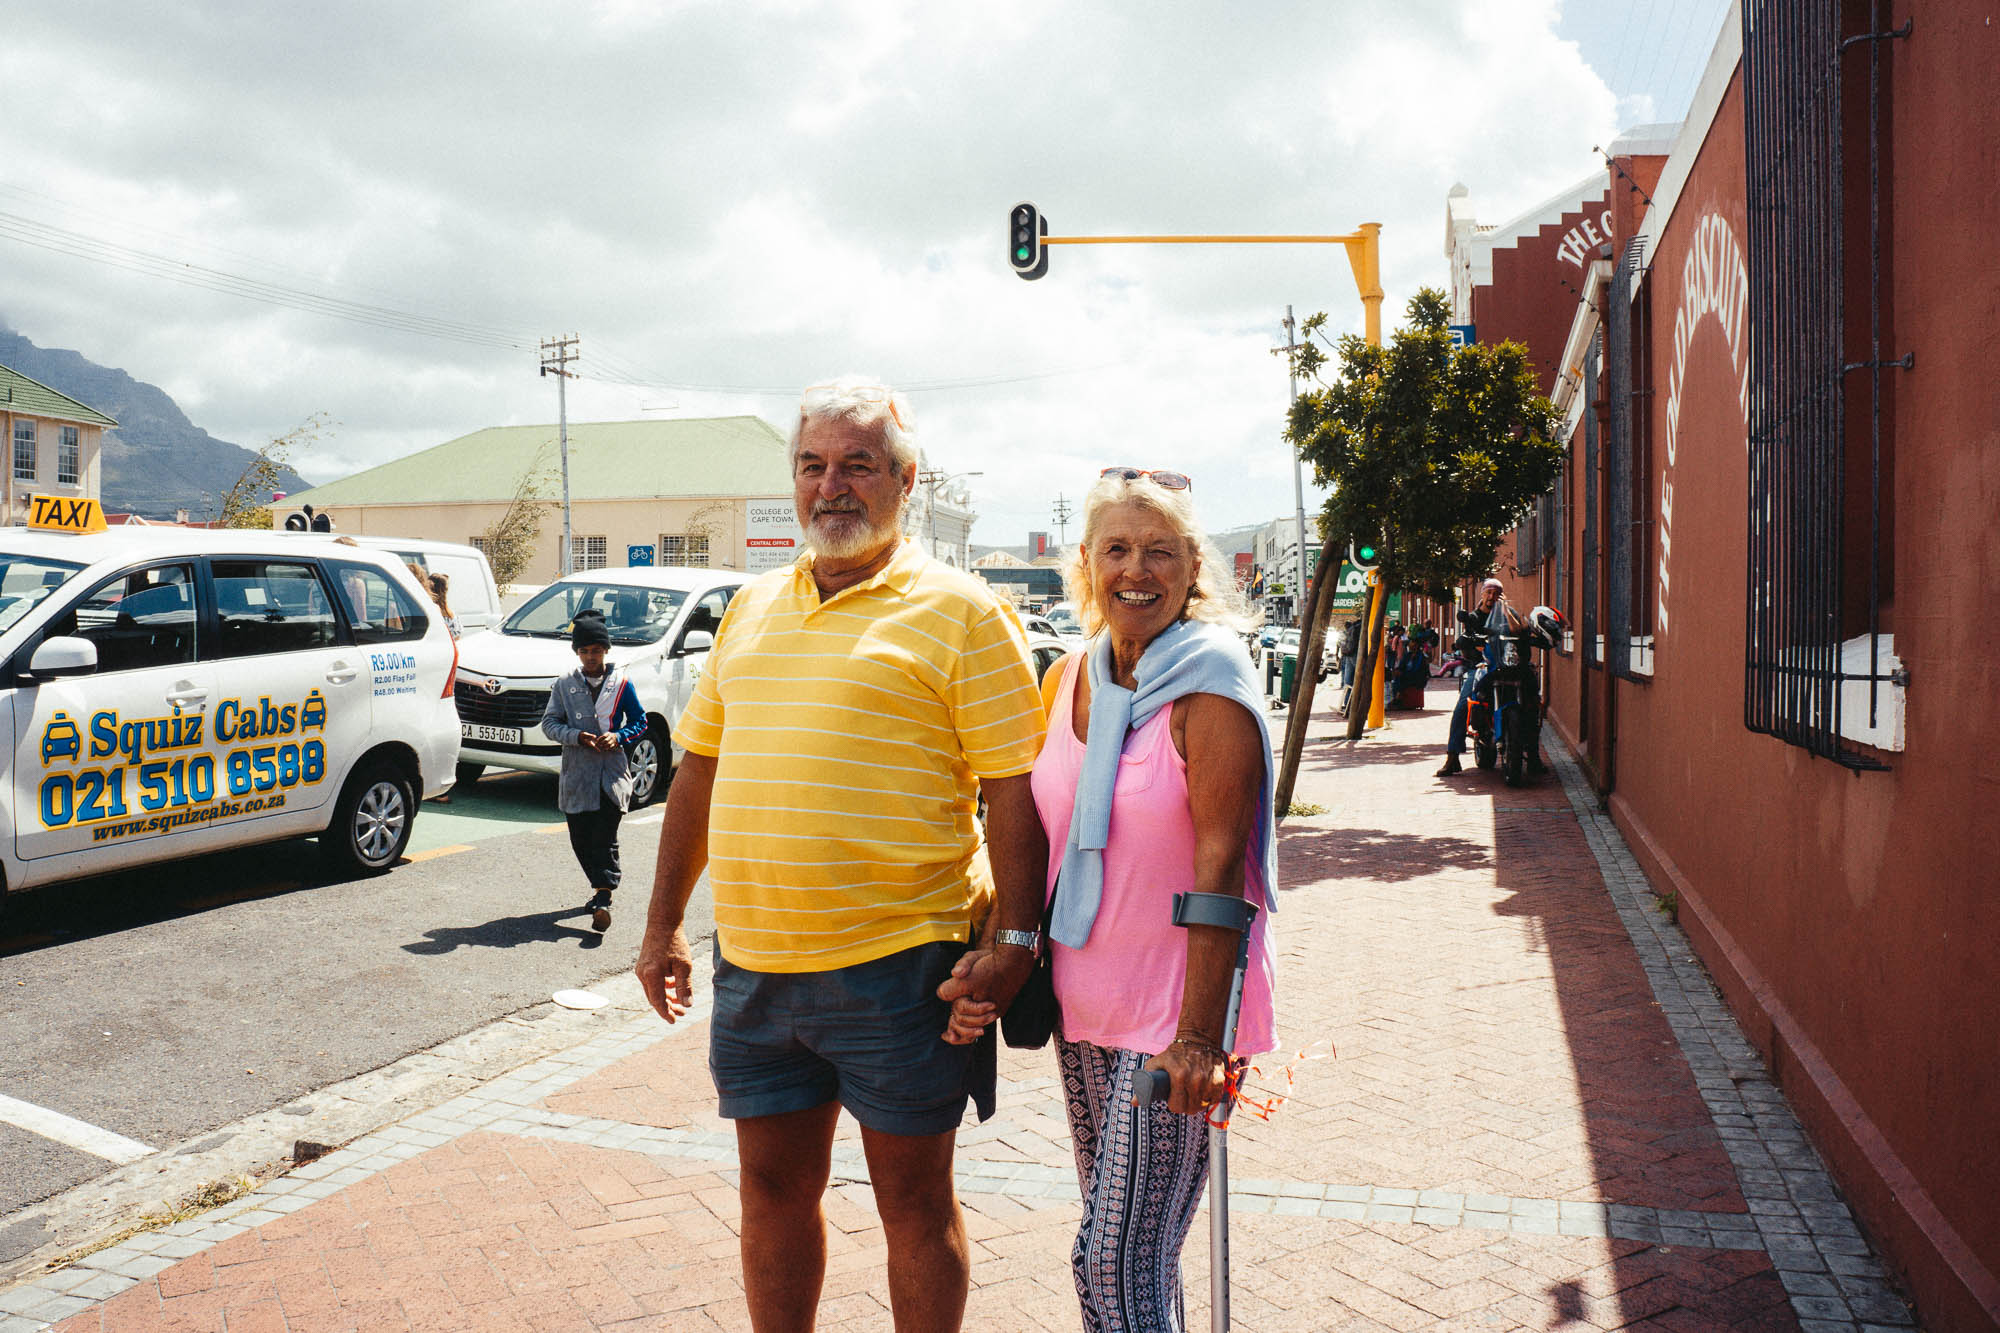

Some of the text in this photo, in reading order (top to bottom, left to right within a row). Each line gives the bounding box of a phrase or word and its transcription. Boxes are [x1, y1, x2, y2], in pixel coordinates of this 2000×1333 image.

[1557, 218, 1603, 269] THE
[1658, 470, 1674, 636] THE
[1666, 307, 1686, 467] OLD
[1684, 212, 1749, 376] BISCUIT
[34, 497, 92, 528] TAXI
[750, 508, 781, 516] COLLEGE
[370, 653, 416, 671] R9.00 km
[374, 675, 392, 684] R2.00
[90, 697, 297, 766] Squiz Cabs
[461, 724, 517, 743] CA 553-063
[40, 740, 325, 827] 021 510 8588
[93, 794, 286, 841] www.squizcabs.co.za
